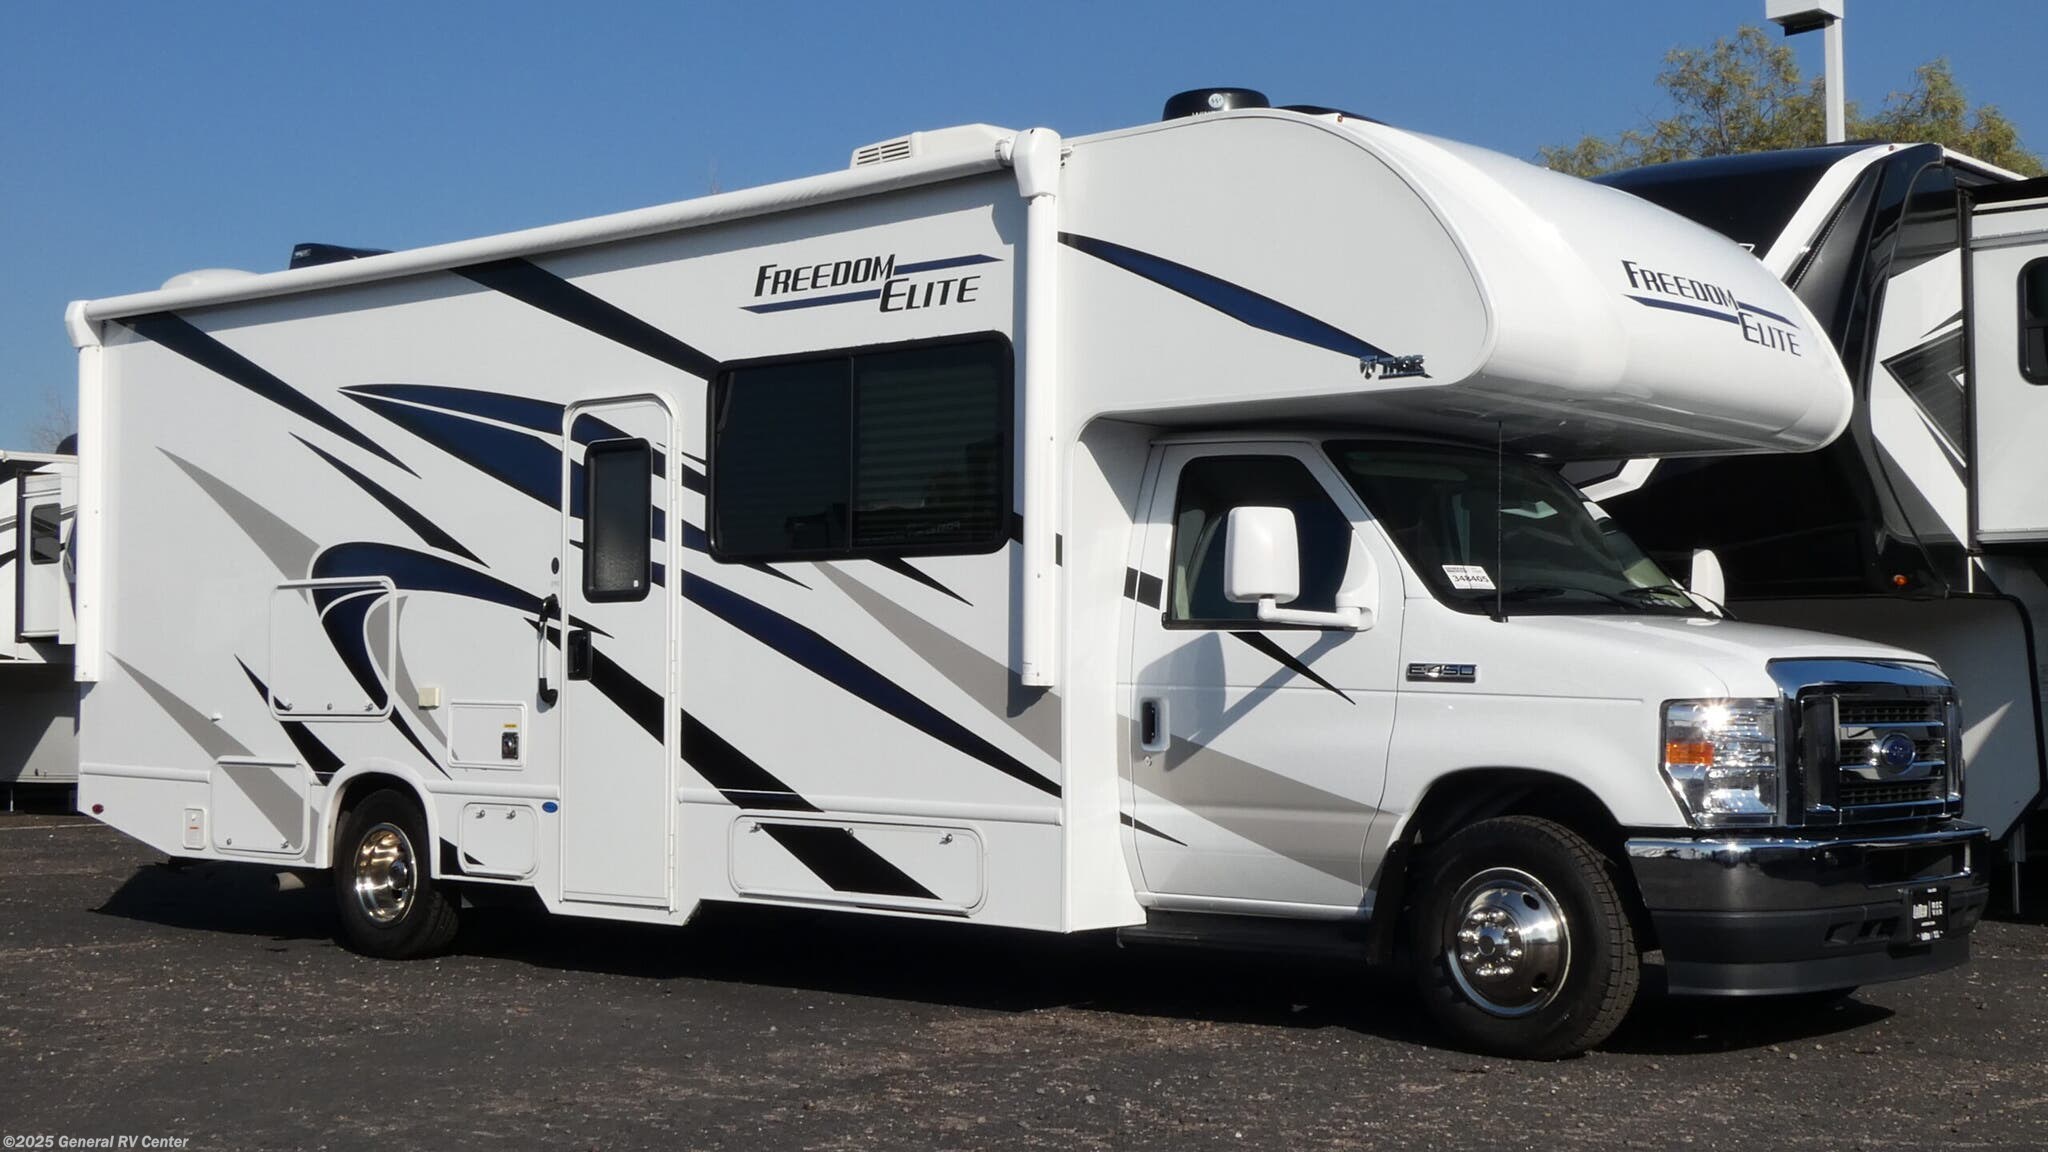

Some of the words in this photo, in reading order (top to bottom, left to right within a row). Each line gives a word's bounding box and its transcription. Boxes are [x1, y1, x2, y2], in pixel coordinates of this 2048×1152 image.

[754, 254, 896, 297] FREEDOM
[879, 275, 981, 313] ELITE
[1621, 260, 1739, 311] FREEDOM
[1738, 311, 1801, 357] ELITE
